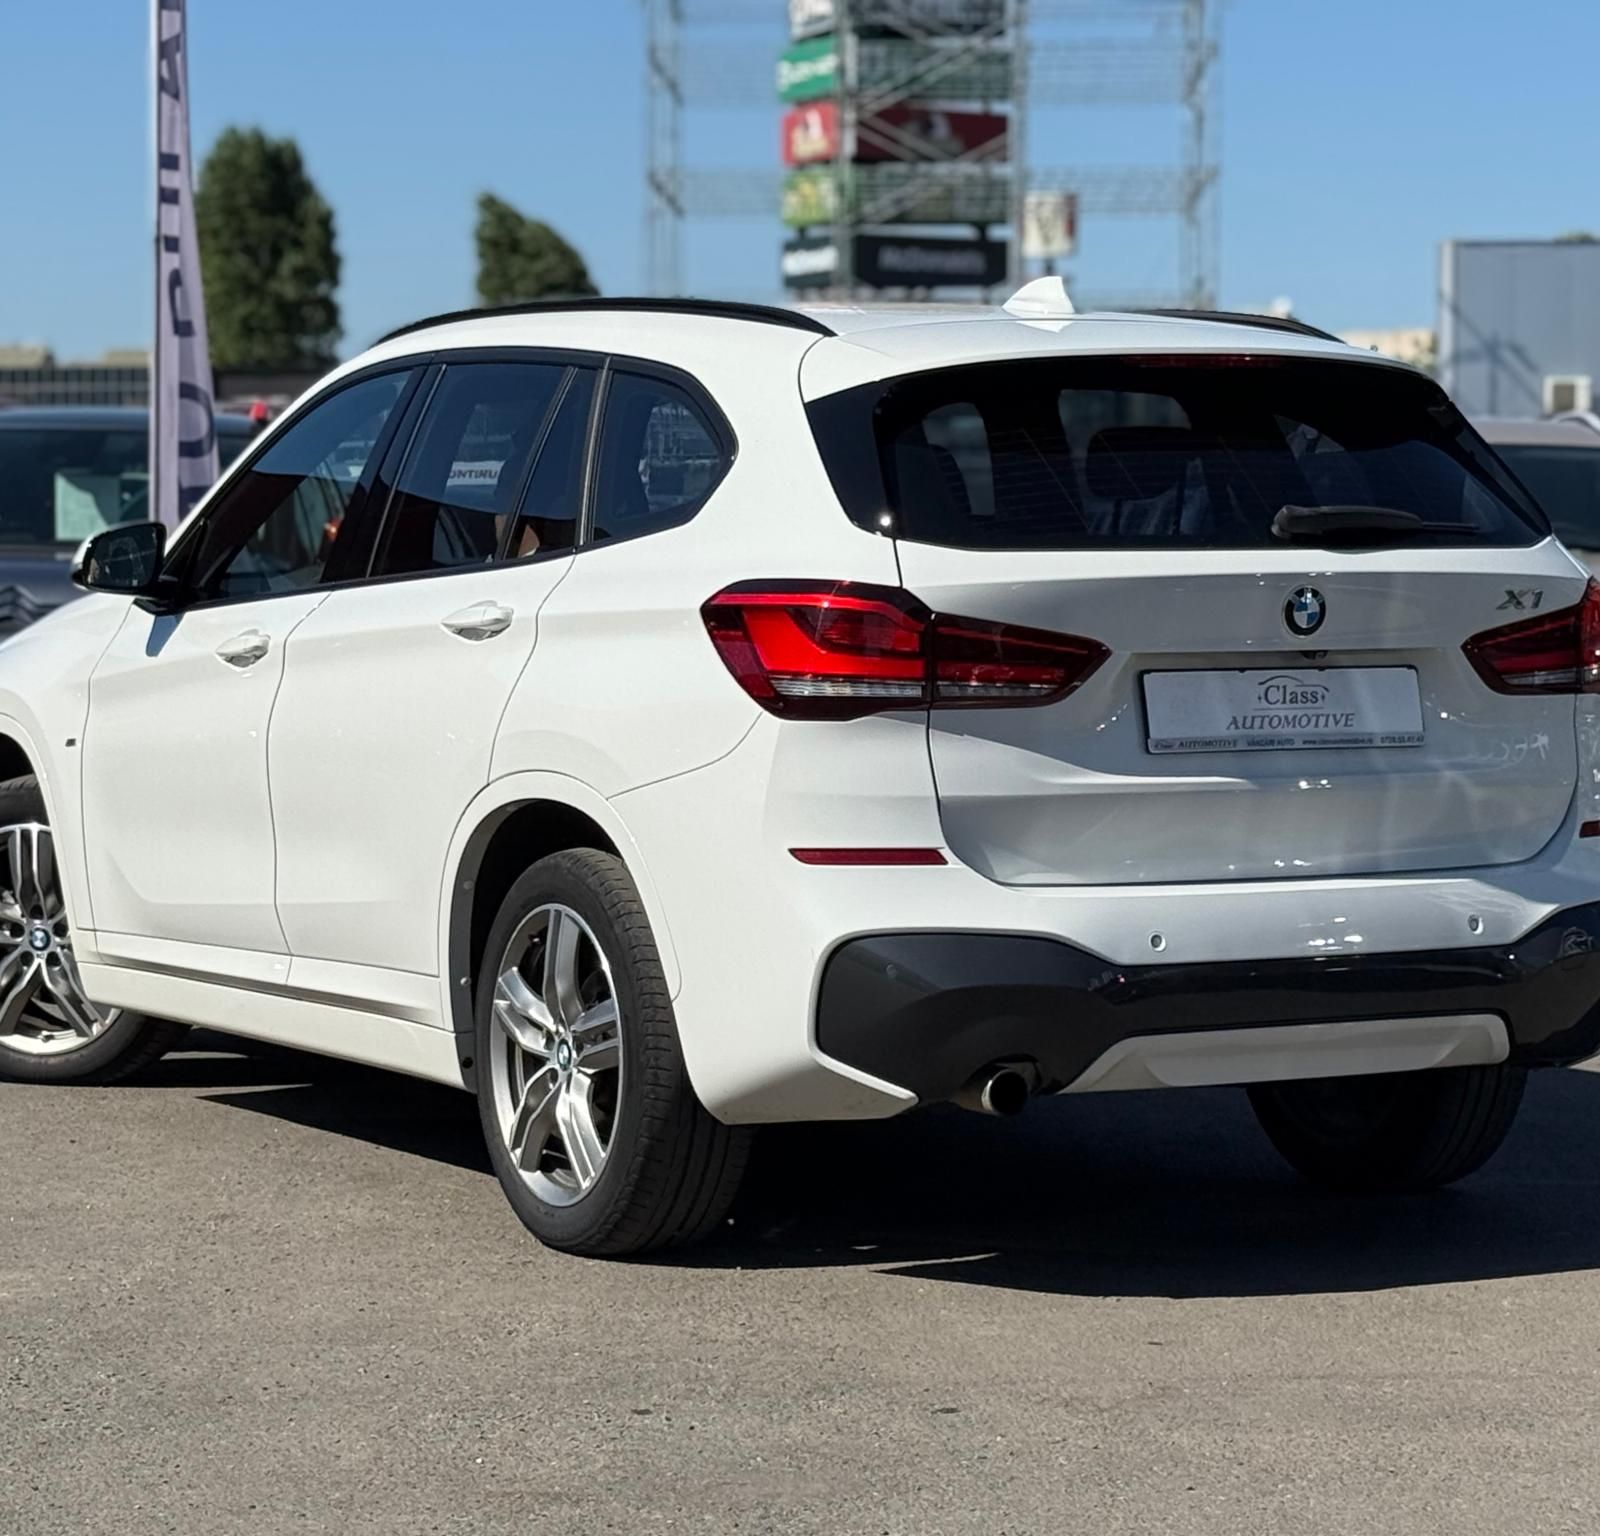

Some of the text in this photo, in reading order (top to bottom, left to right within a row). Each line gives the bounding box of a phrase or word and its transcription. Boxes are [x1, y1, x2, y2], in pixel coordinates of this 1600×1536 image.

[1496, 589, 1545, 610] X1
[1264, 685, 1320, 705] Class
[1226, 713, 1355, 731] AUTOMOTIVE
[1178, 739, 1238, 749] AUTOMOTIVE
